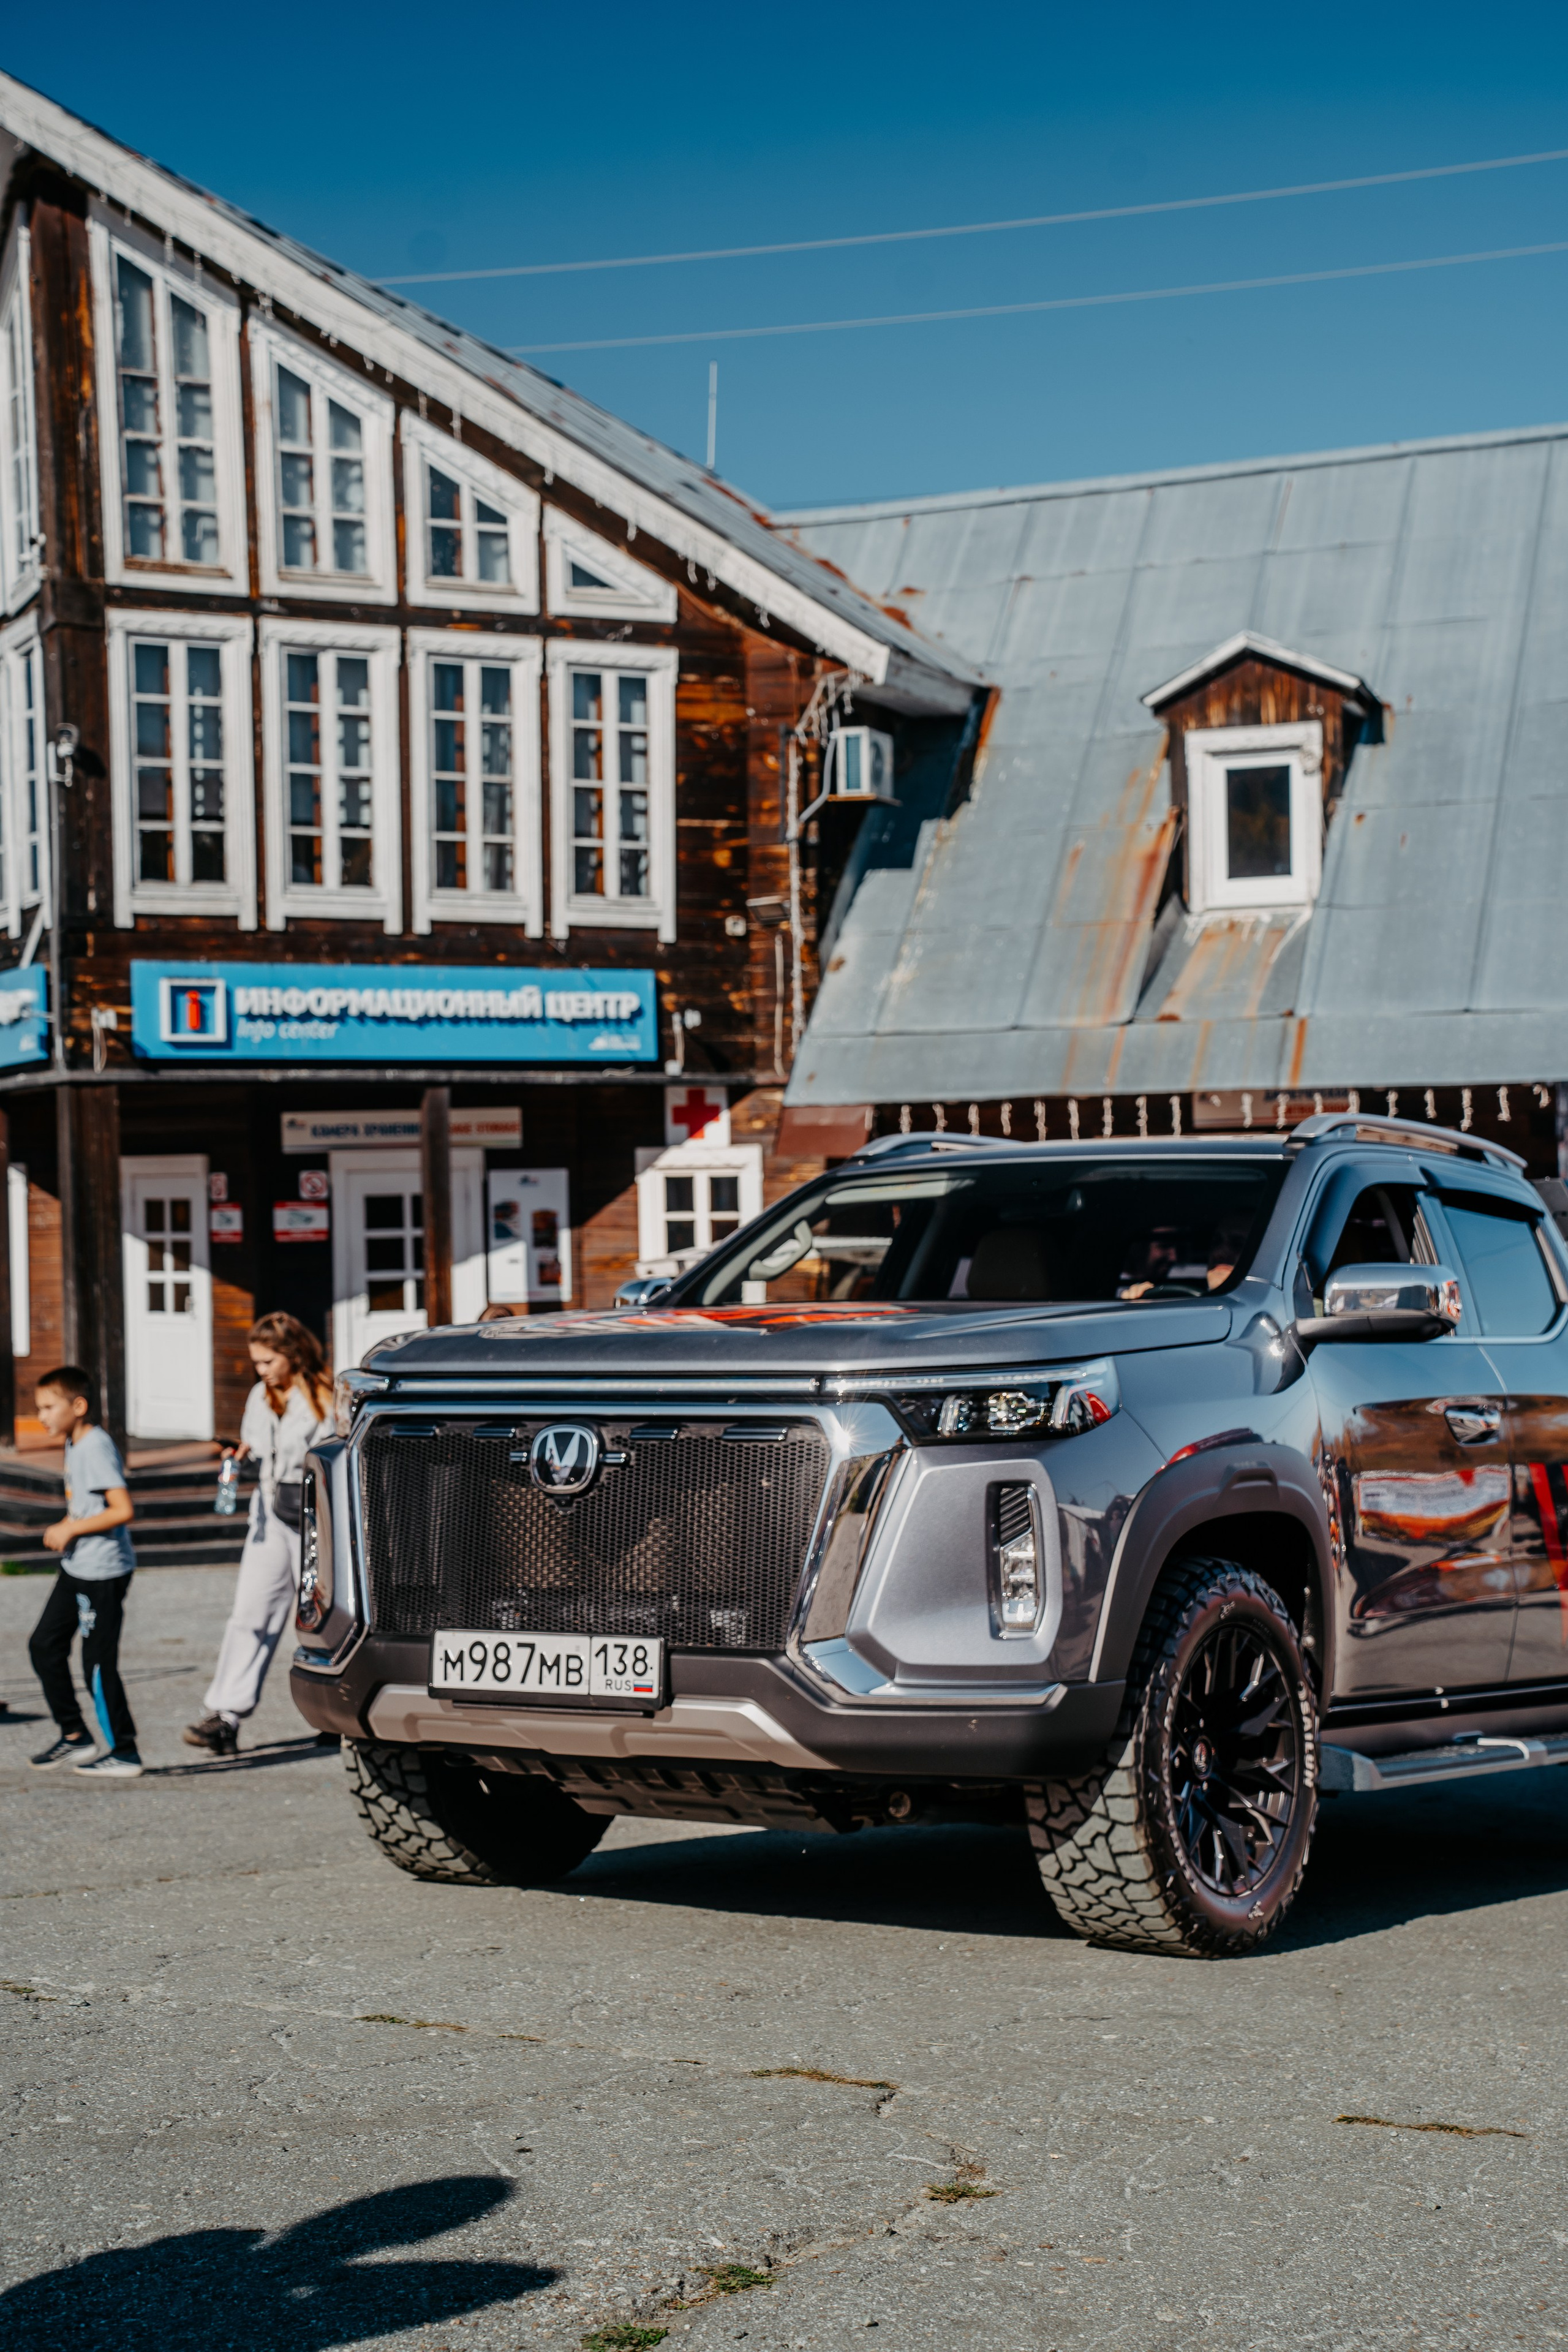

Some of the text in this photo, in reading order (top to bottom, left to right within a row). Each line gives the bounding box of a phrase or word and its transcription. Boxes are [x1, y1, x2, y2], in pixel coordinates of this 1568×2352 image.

[235, 985, 641, 1022] ИНФОРМАЦИОННЫЙ ЦЕНТР
[444, 1641, 648, 1686] М987МВ 138
[605, 1679, 631, 1692] RUS
